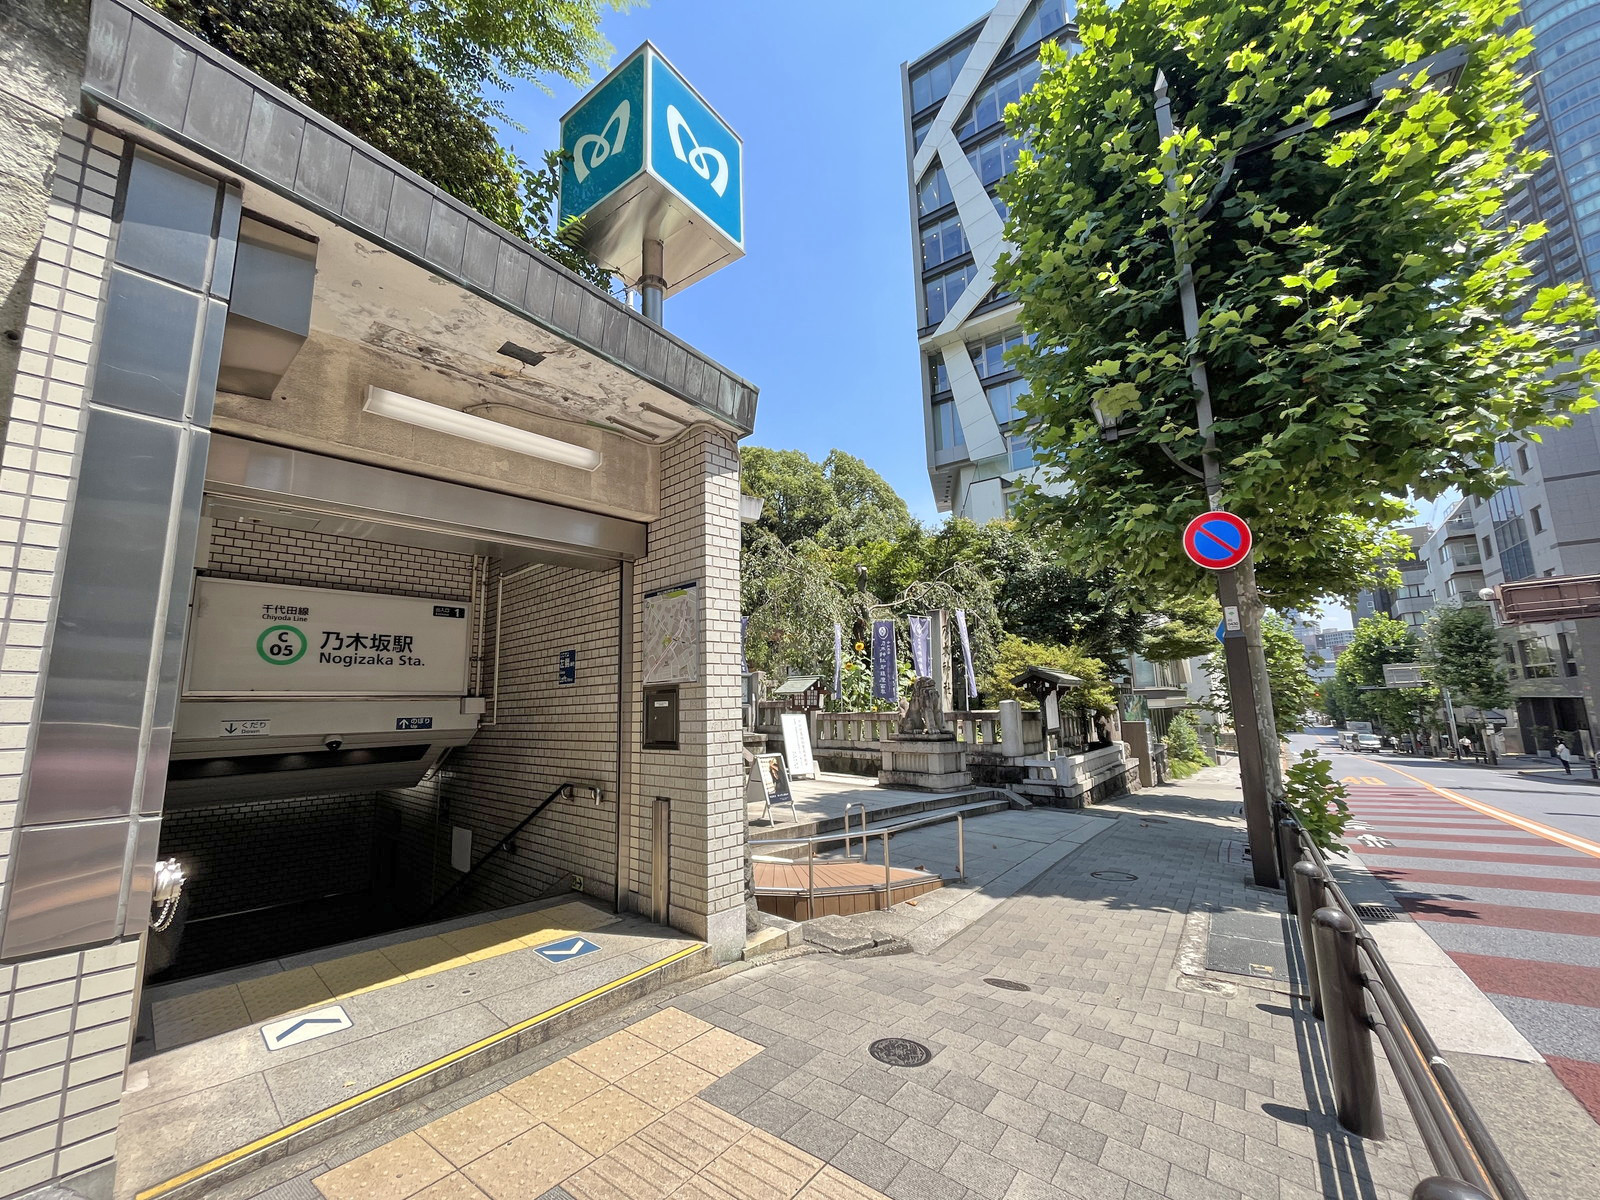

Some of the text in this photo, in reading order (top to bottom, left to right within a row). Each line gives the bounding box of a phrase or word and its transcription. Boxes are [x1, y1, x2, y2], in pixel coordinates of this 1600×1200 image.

[262, 604, 309, 615] 千代田線
[454, 608, 460, 617] 1
[262, 614, 292, 622] Chiyoda
[278, 632, 288, 642] C
[320, 631, 413, 653] 乃木坂駅
[269, 643, 293, 656] 05
[319, 651, 425, 667] Nogizaka Sta.
[241, 721, 267, 729] くだり
